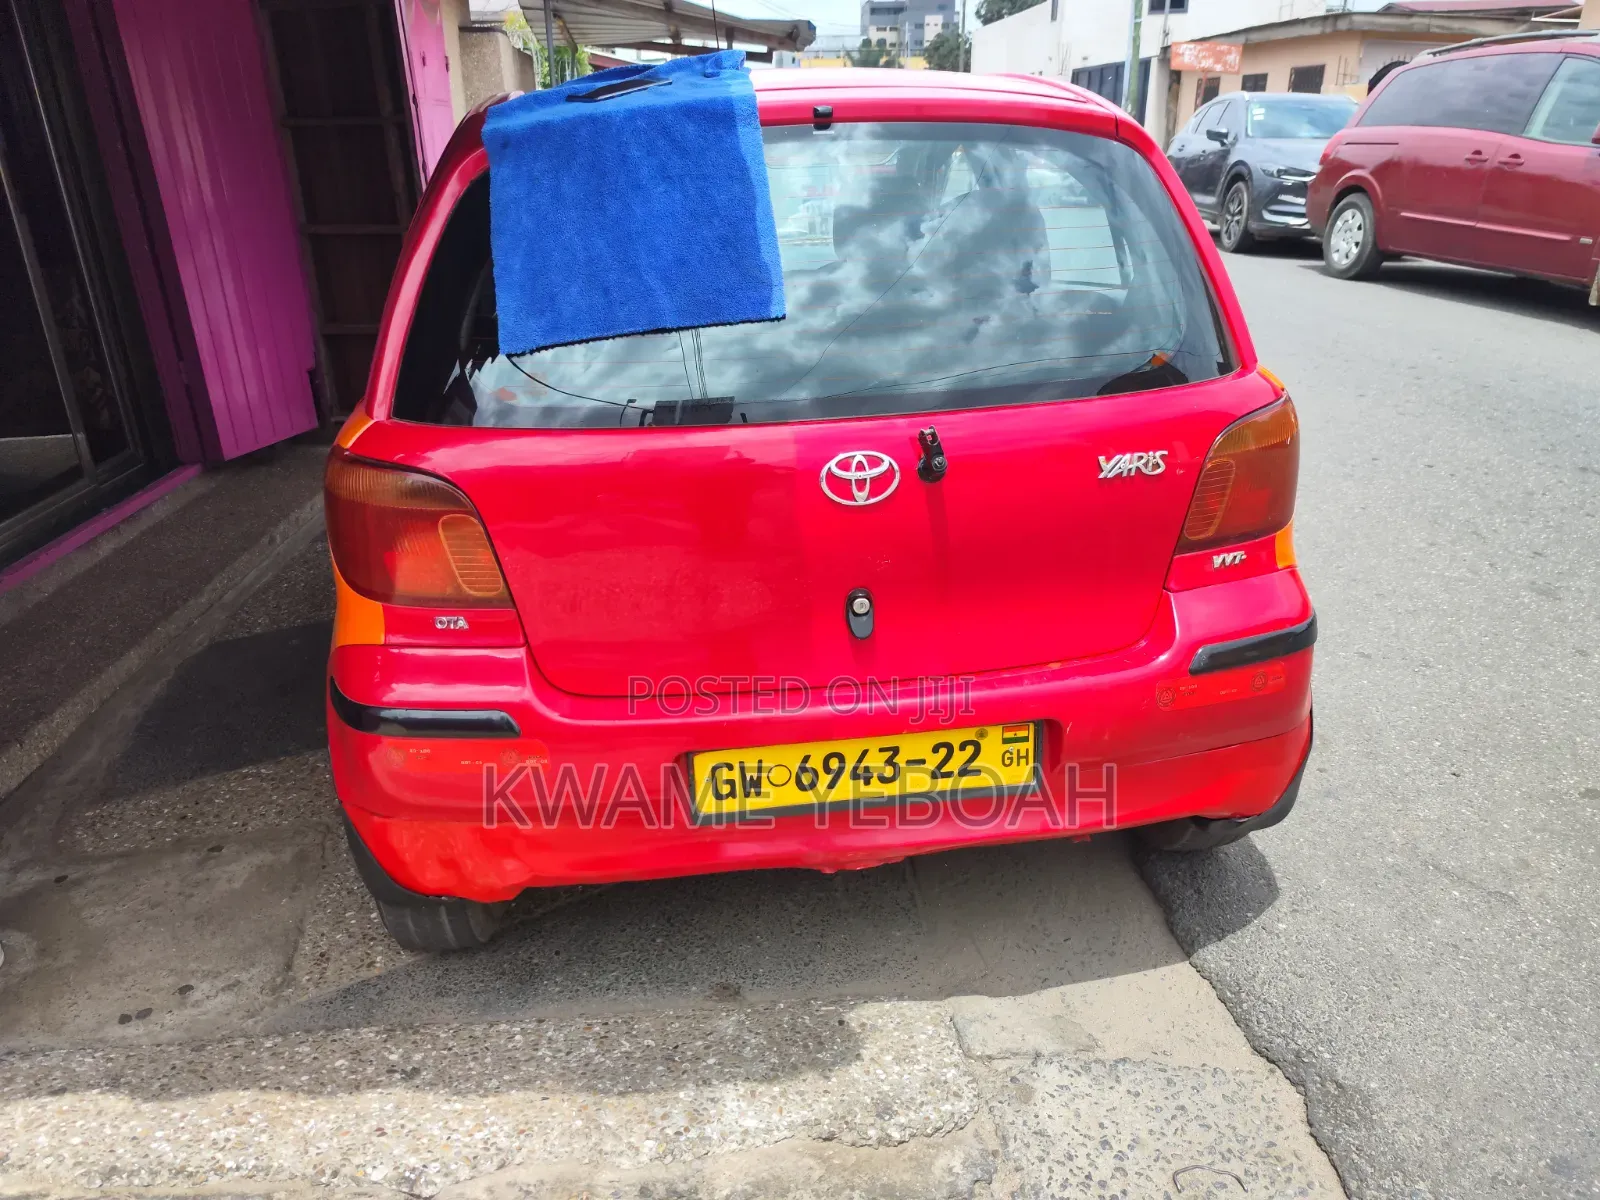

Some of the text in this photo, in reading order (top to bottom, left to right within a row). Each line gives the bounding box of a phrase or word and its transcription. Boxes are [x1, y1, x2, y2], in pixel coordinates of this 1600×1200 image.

[711, 739, 982, 801] GW 6943-22
[1001, 747, 1030, 768] GH
